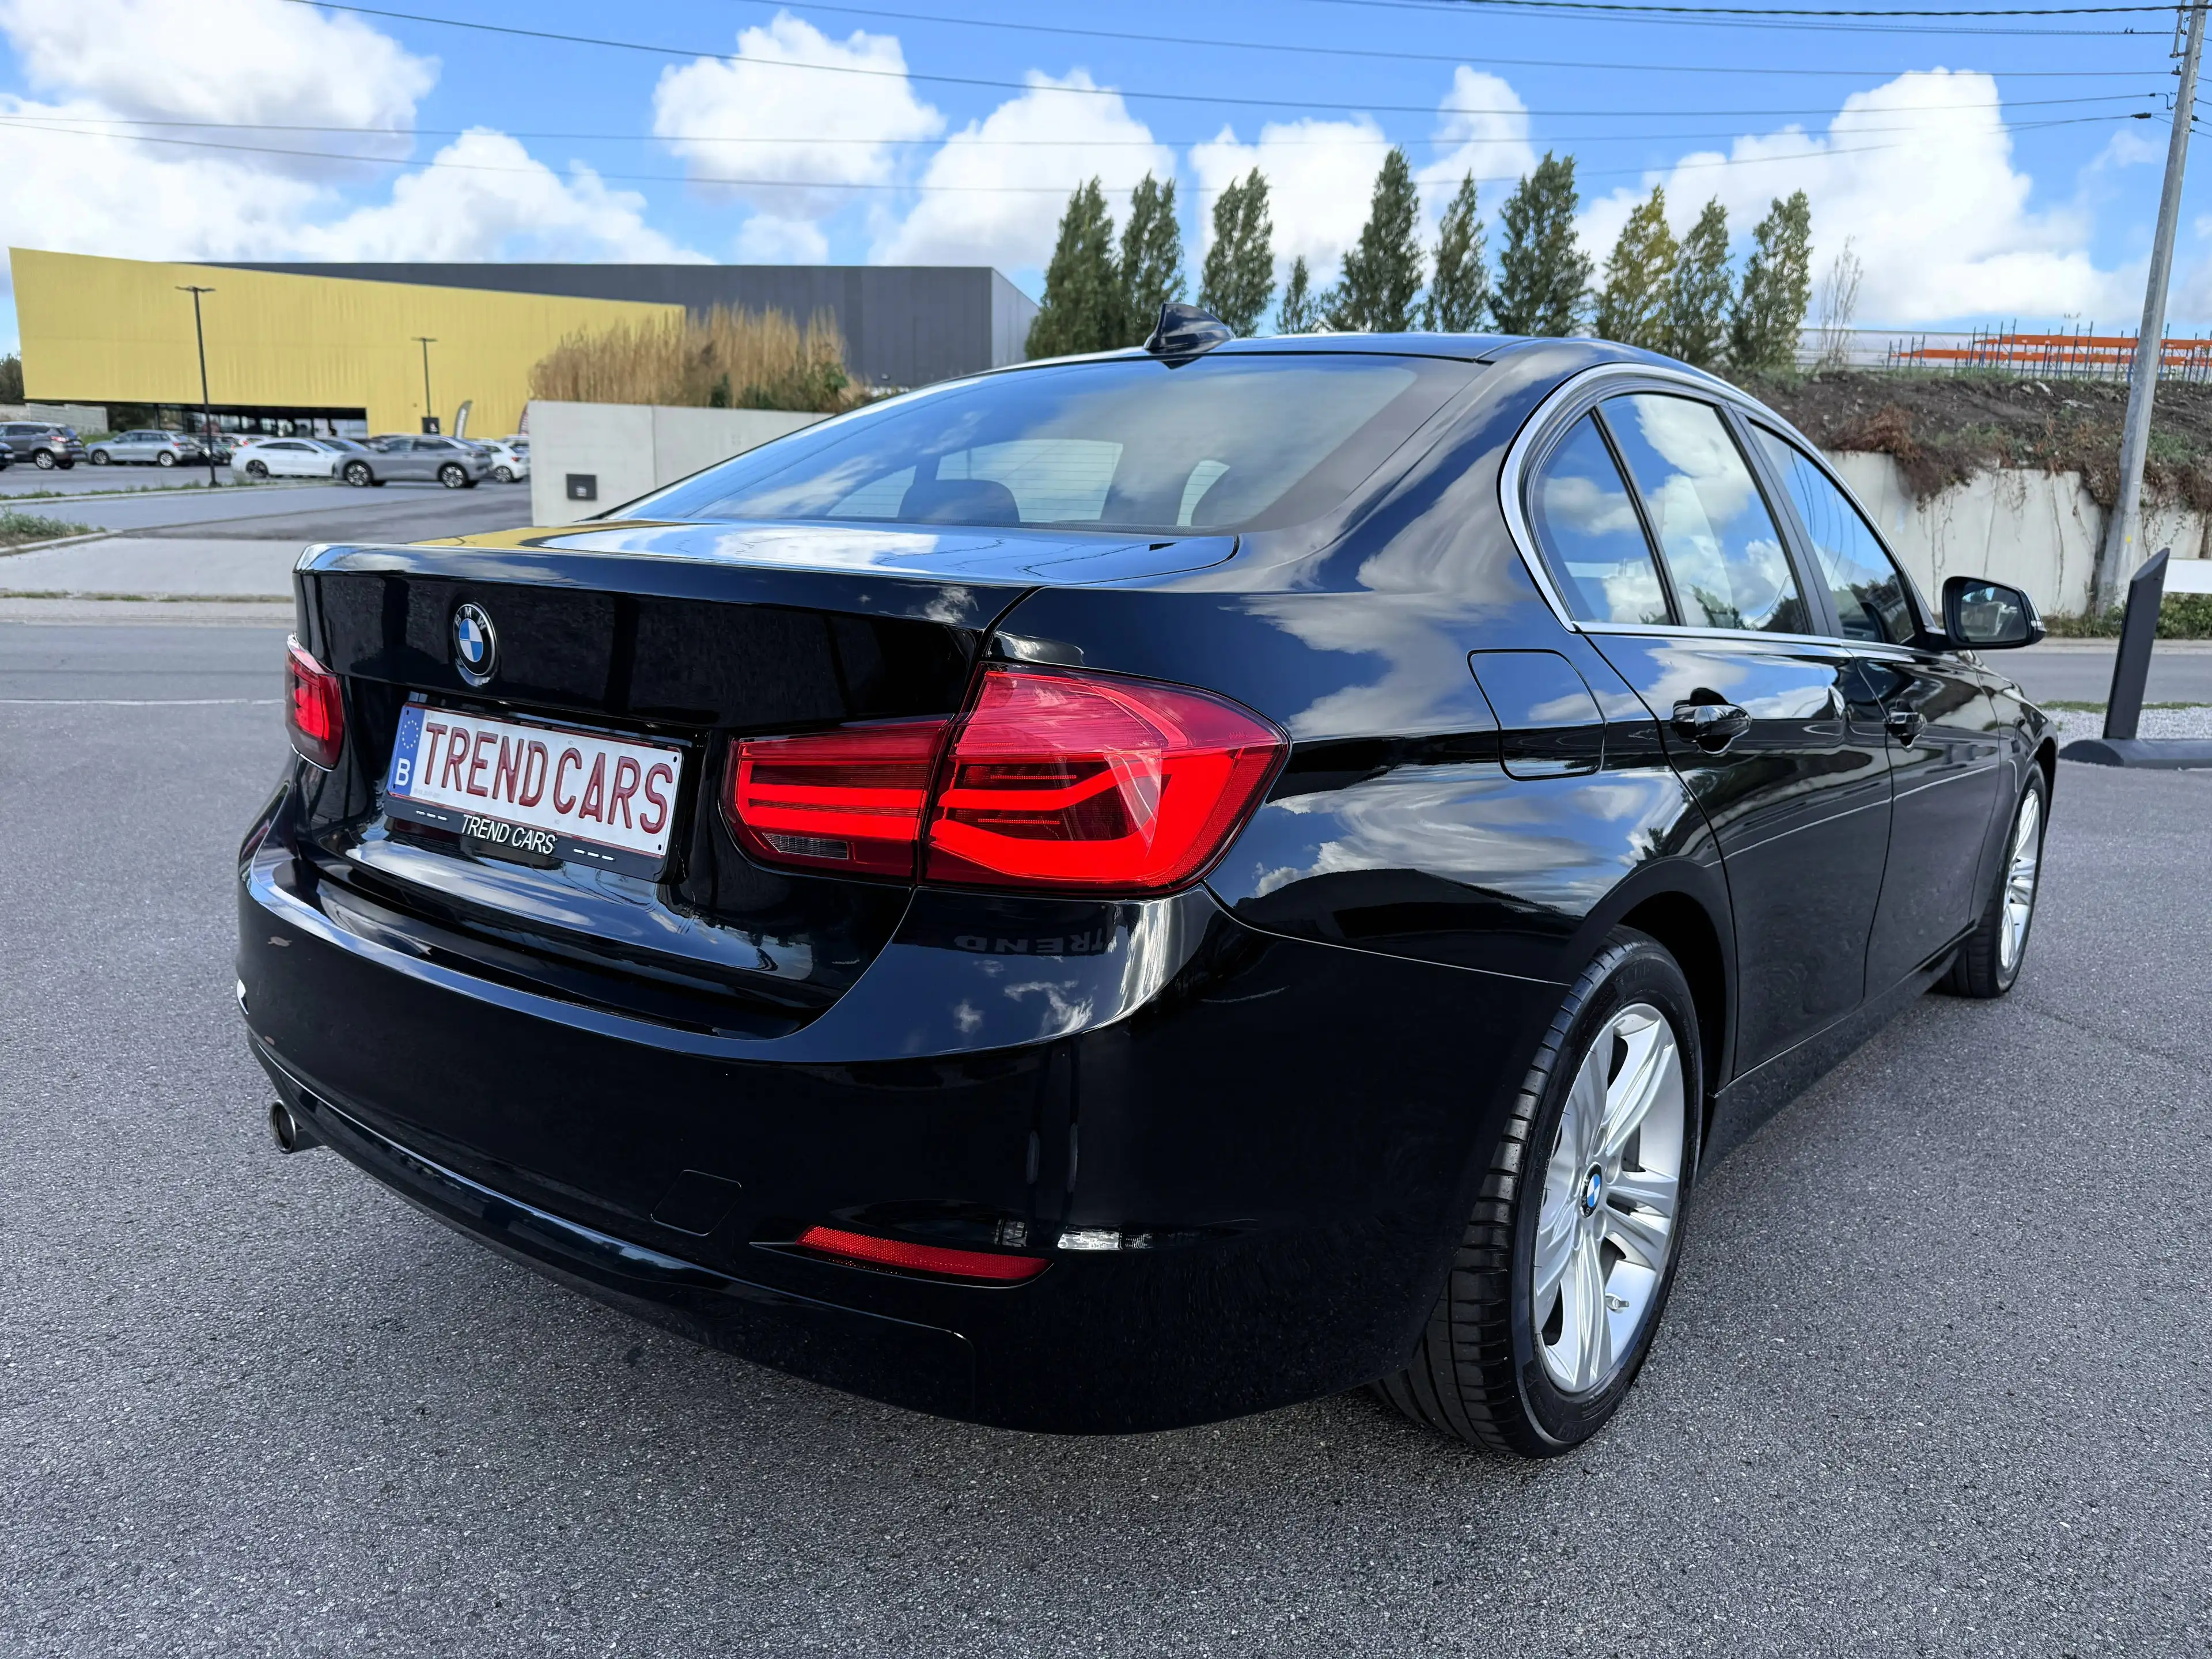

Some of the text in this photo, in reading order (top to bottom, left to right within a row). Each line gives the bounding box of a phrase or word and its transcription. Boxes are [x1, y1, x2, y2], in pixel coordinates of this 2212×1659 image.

[454, 607, 487, 630] BMW
[395, 757, 411, 786] B
[461, 814, 556, 854] TREND CARS
